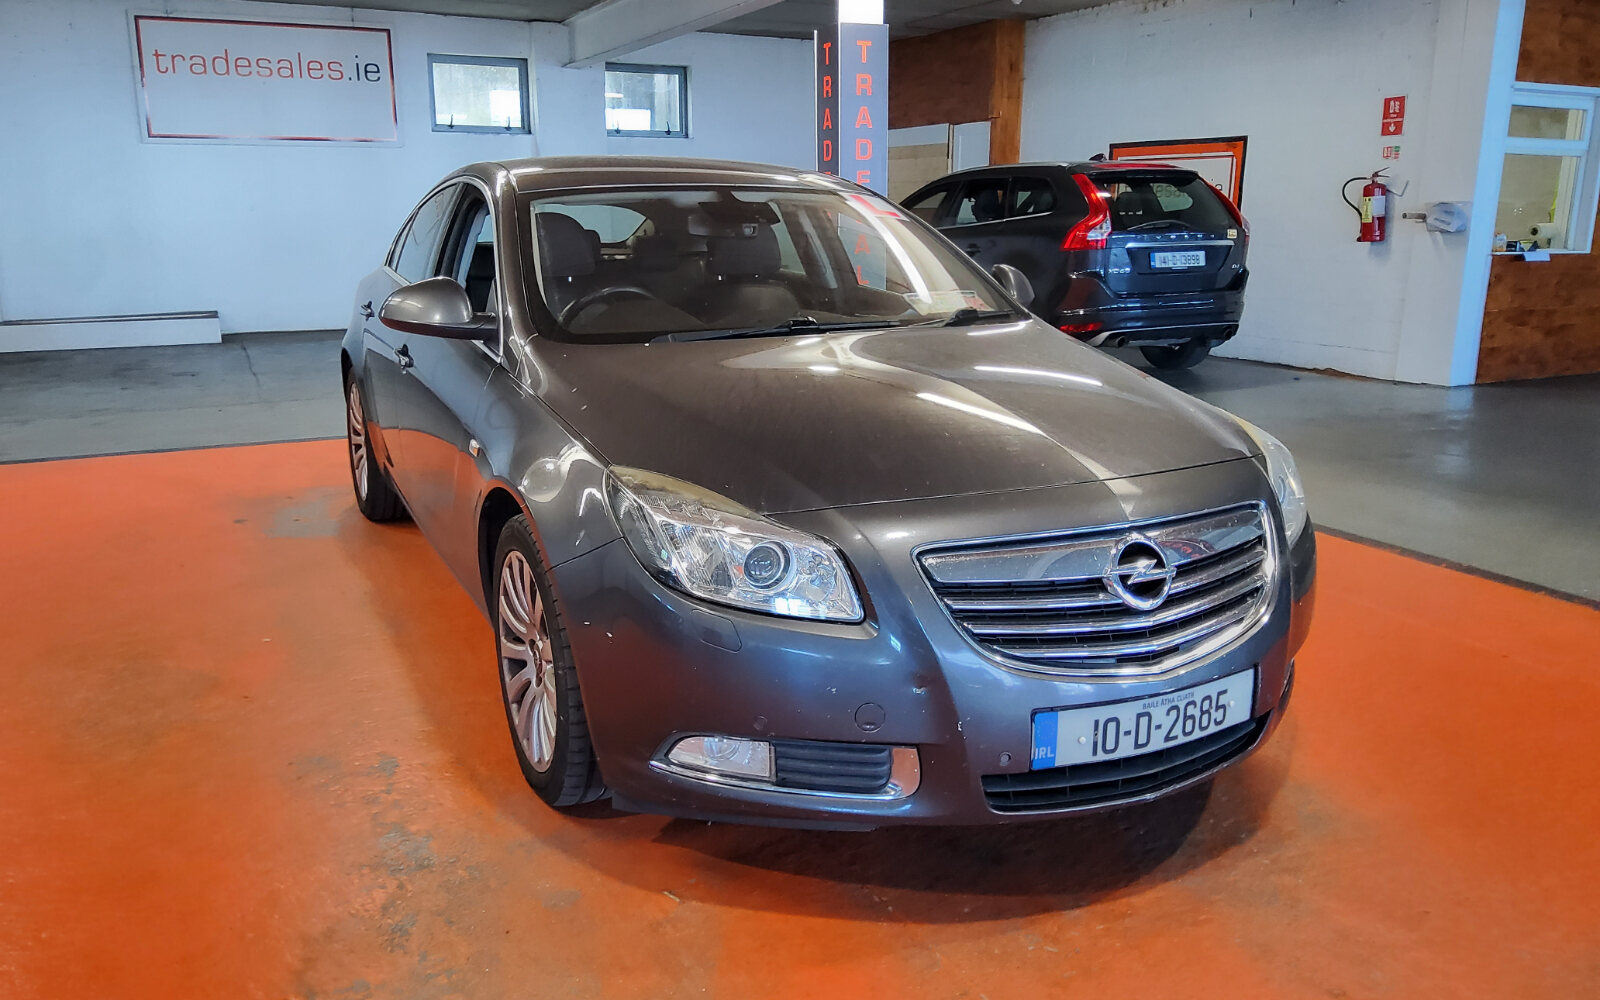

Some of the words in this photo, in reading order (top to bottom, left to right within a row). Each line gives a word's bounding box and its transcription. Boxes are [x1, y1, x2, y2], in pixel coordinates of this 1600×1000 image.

[152, 48, 382, 83] tradesales.ie
[1142, 700, 1160, 710] BAILE
[1092, 688, 1229, 757] 10-D-2685
[1034, 746, 1055, 760] IRL
